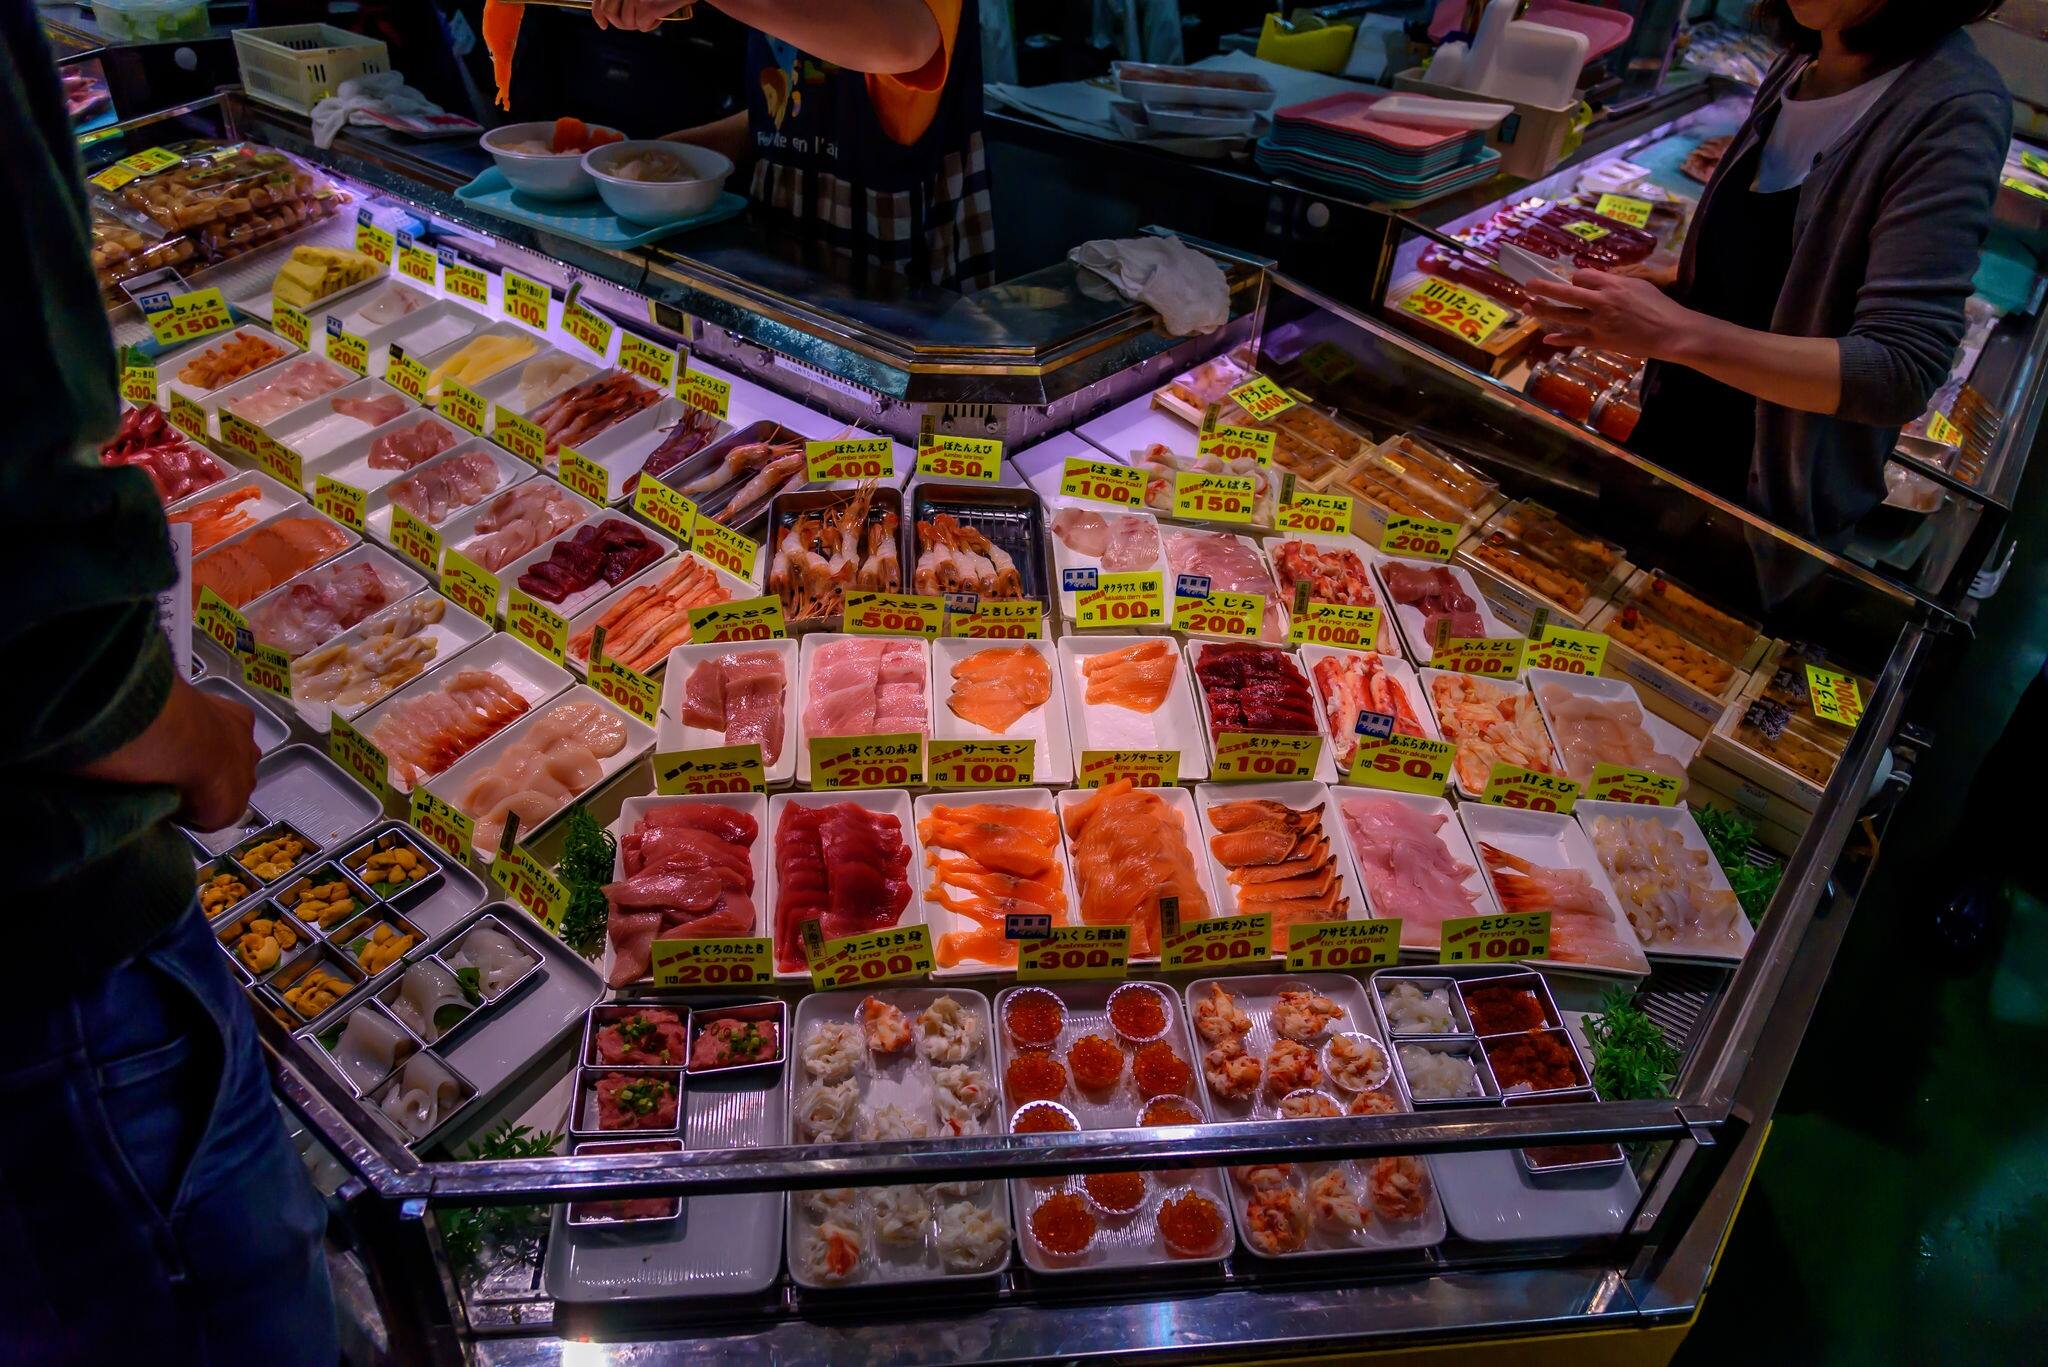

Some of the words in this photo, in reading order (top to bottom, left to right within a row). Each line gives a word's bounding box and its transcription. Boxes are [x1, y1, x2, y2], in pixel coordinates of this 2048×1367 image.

[175, 299, 216, 315] さんま
[1424, 284, 1496, 324] 甘口たらこ
[575, 458, 604, 480] はまち
[1090, 464, 1140, 481] はまち
[659, 488, 690, 512] くじら
[1301, 498, 1346, 510] かに足
[1410, 521, 1452, 535] 中とろ
[714, 527, 752, 553] ズワイガニ
[462, 570, 496, 598] つぶ
[878, 599, 937, 611] 大とろ
[1205, 596, 1255, 609] くじら
[528, 603, 563, 629] 甘えび
[722, 606, 777, 621] 大とろ
[980, 606, 1037, 616] ときしらず
[1319, 607, 1374, 621] かに足
[1462, 642, 1516, 655] ふんどし
[1551, 637, 1600, 655] ほたて
[610, 662, 656, 693] ほたて
[963, 744, 1028, 754] サーモン
[1248, 737, 1312, 748] 炙りサーモン
[1390, 735, 1448, 753] あぶらかれい
[852, 744, 918, 757] まぐろの赤身
[1113, 752, 1173, 763] キングサーモン
[696, 759, 759, 772] 中とろ
[854, 758, 909, 766] tuna
[1523, 773, 1575, 792] 甘えび
[1626, 773, 1676, 790] つぶ
[425, 793, 464, 829] 生うに
[521, 857, 561, 902] いかそうめん
[1196, 918, 1264, 934] 花咲かに
[1480, 916, 1541, 930] とびっこ
[1055, 929, 1126, 940] いくら醤油
[1205, 930, 1265, 940] crab
[1319, 925, 1389, 937] ワサビえんがわ
[693, 943, 764, 954] まぐろのたたき
[843, 931, 923, 952] カニむき身
[848, 951, 880, 961] king
[886, 944, 924, 955] crab
